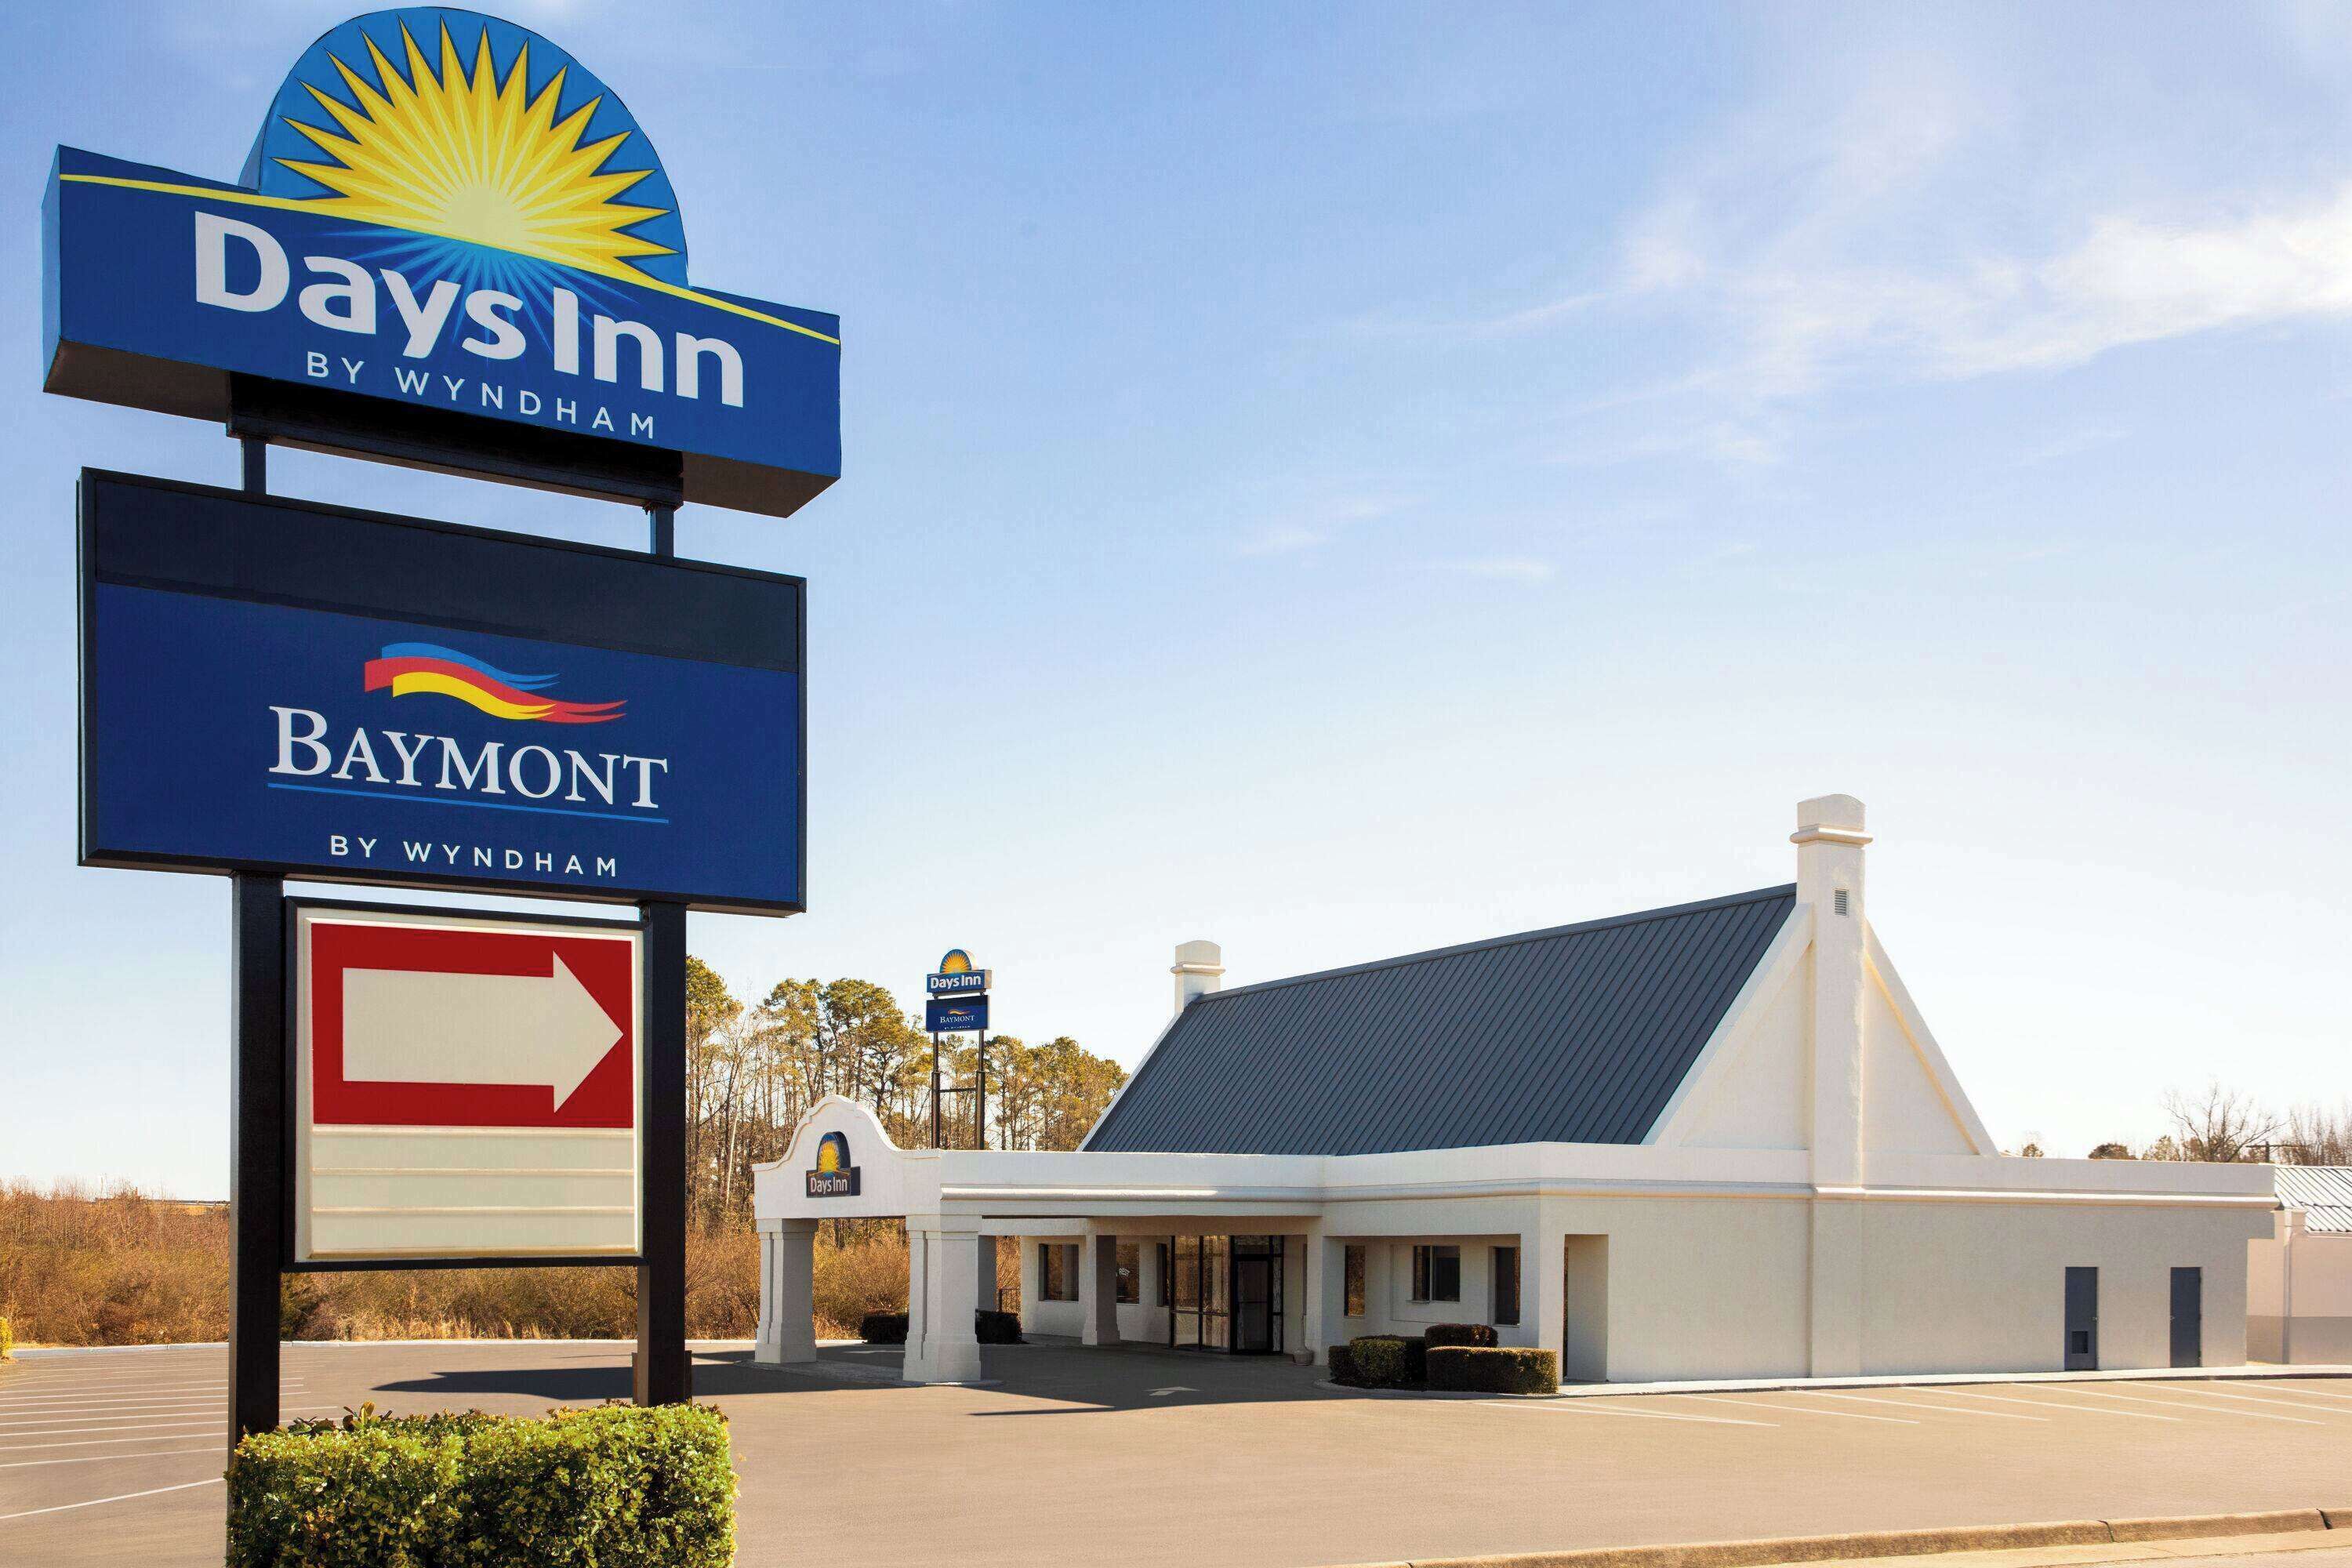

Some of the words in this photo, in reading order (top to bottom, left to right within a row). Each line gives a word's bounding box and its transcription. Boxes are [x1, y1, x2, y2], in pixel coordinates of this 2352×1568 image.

[194, 211, 526, 359] Days
[553, 286, 744, 408] Inn
[307, 350, 365, 384] BY
[394, 367, 654, 439] WYNDHAM
[268, 706, 668, 808] BAYMONT
[330, 835, 377, 858] BY
[402, 840, 616, 877] WYNDHAM
[930, 977, 960, 989] Days
[961, 975, 982, 986] Inn
[810, 1177, 832, 1194] Days
[833, 1176, 848, 1191] Inn
